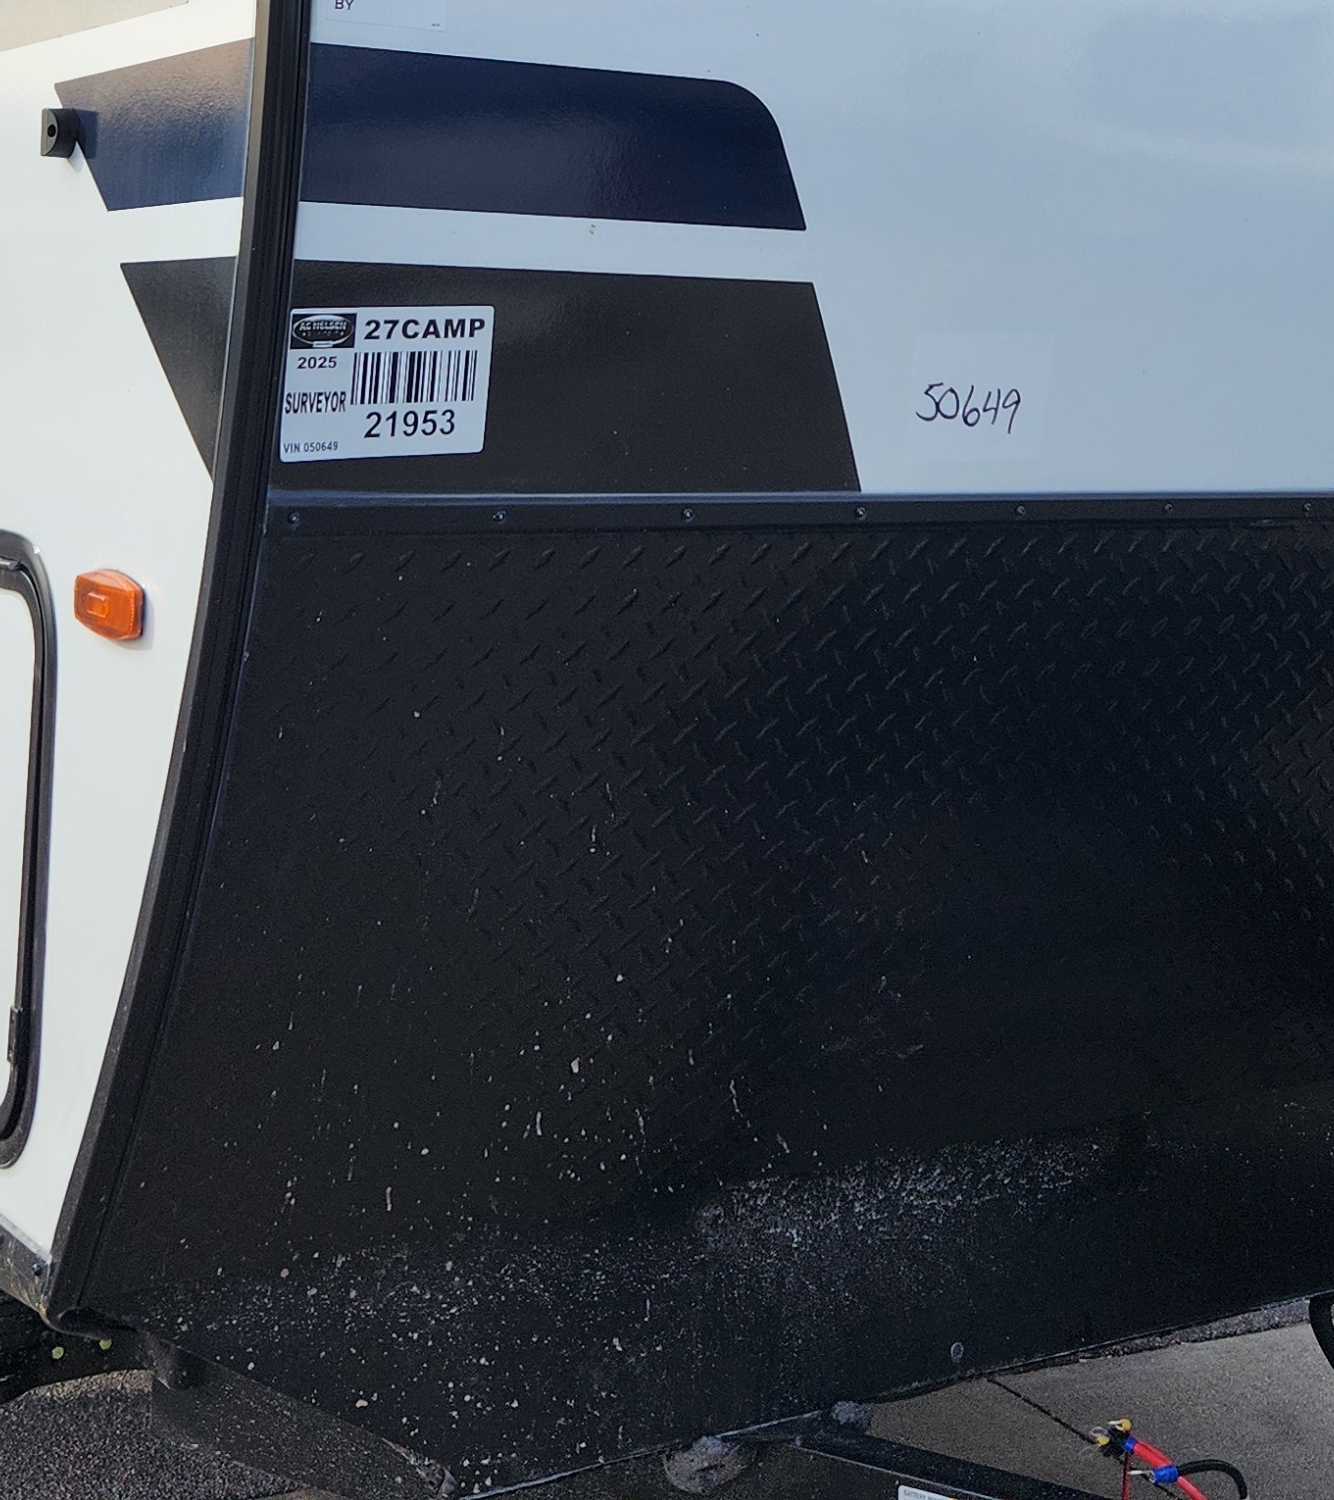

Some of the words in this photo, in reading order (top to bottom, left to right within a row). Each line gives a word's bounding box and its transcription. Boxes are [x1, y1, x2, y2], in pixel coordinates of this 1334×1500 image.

[364, 318, 486, 340] 27CAMP
[297, 356, 338, 369] 2025
[284, 391, 347, 414] SURVEYOR
[915, 382, 1021, 434] 50649
[364, 409, 455, 438] 21953
[283, 443, 301, 453] VIN
[303, 441, 339, 452] 050649
